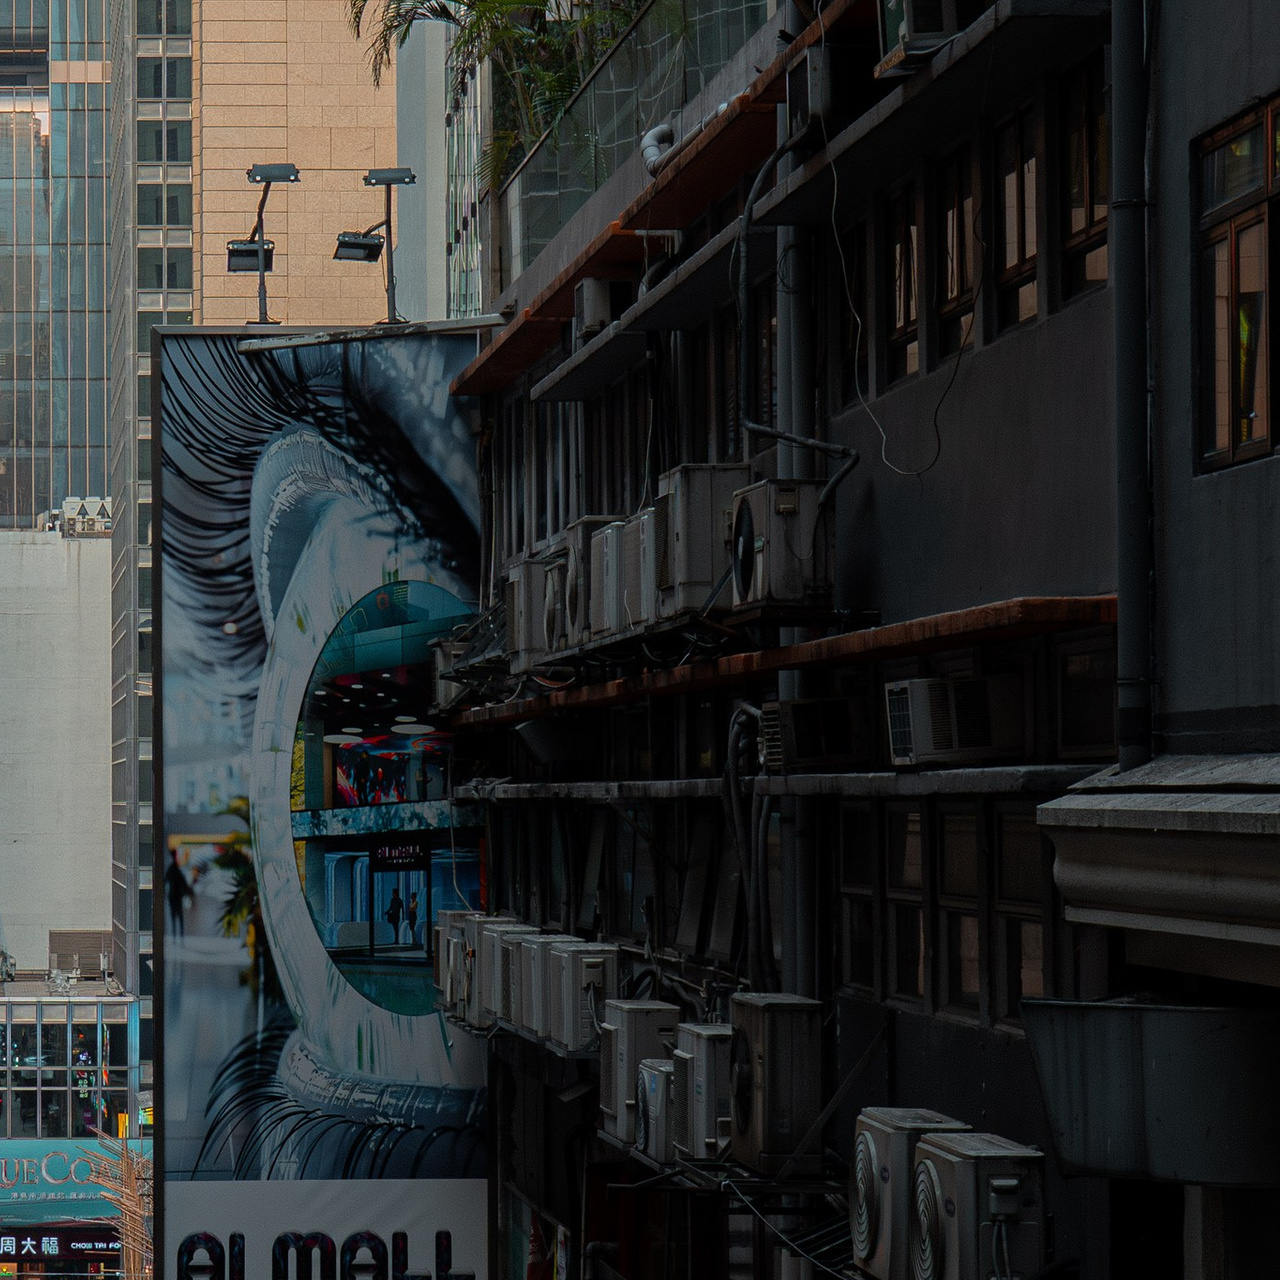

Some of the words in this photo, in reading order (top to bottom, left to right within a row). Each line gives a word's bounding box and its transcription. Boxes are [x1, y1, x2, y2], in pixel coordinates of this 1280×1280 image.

[0, 1236, 59, 1255] 周大福
[71, 1242, 93, 1250] CHOW
